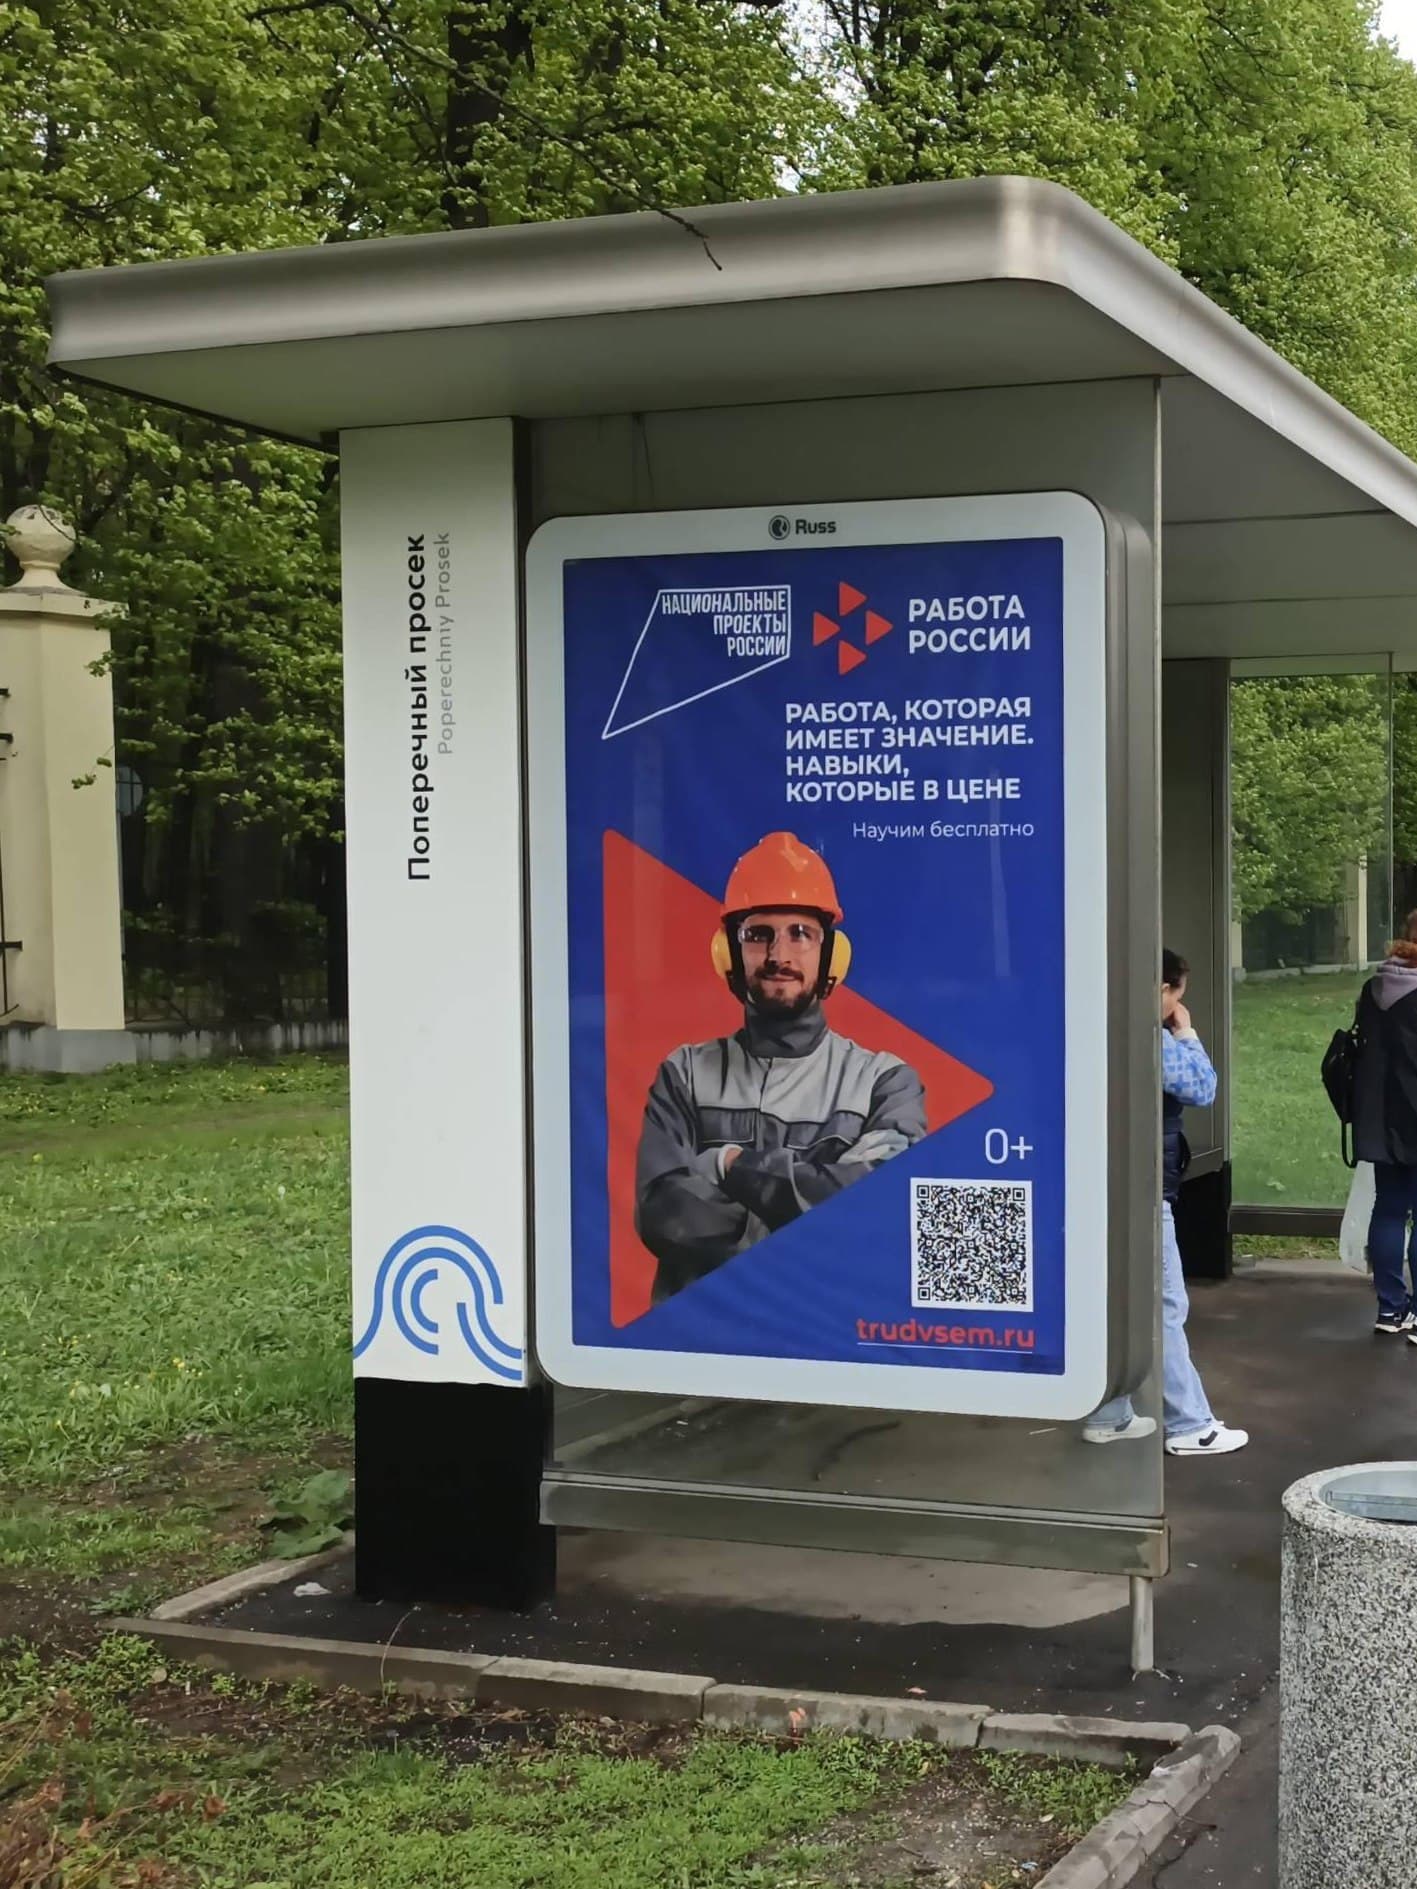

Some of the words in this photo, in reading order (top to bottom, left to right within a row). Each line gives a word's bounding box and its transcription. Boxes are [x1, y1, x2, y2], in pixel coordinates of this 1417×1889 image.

[795, 519, 837, 535] Russ
[435, 531, 450, 607] Prosek
[407, 534, 431, 653] просек
[661, 591, 786, 615] НАЦИОНАЛЬНЫЕ
[908, 595, 1025, 622] РАБОТА
[713, 613, 786, 635] ПРОЕКТЫ
[727, 636, 786, 656] РОССИИ
[908, 626, 1031, 654] РОССИИ
[437, 615, 456, 755] Poperechniy
[786, 702, 897, 724] РАБОТА,
[904, 697, 1031, 720] КОТОРАЯ
[786, 728, 875, 750] ИМЕЕТ
[881, 724, 1034, 748] ЗНАЧЕНИЕ.
[405, 664, 433, 880] Поперечный
[786, 754, 909, 777] НАВЫКИ,
[786, 780, 915, 802] КОТОРЫЕ
[923, 780, 939, 800] В
[947, 778, 1021, 803] ЦЕНЕ
[853, 823, 925, 842] Научим
[930, 820, 1034, 837] бесплатно
[985, 1128, 1033, 1164] 0+
[857, 1318, 1034, 1347] trudvsem.ru
